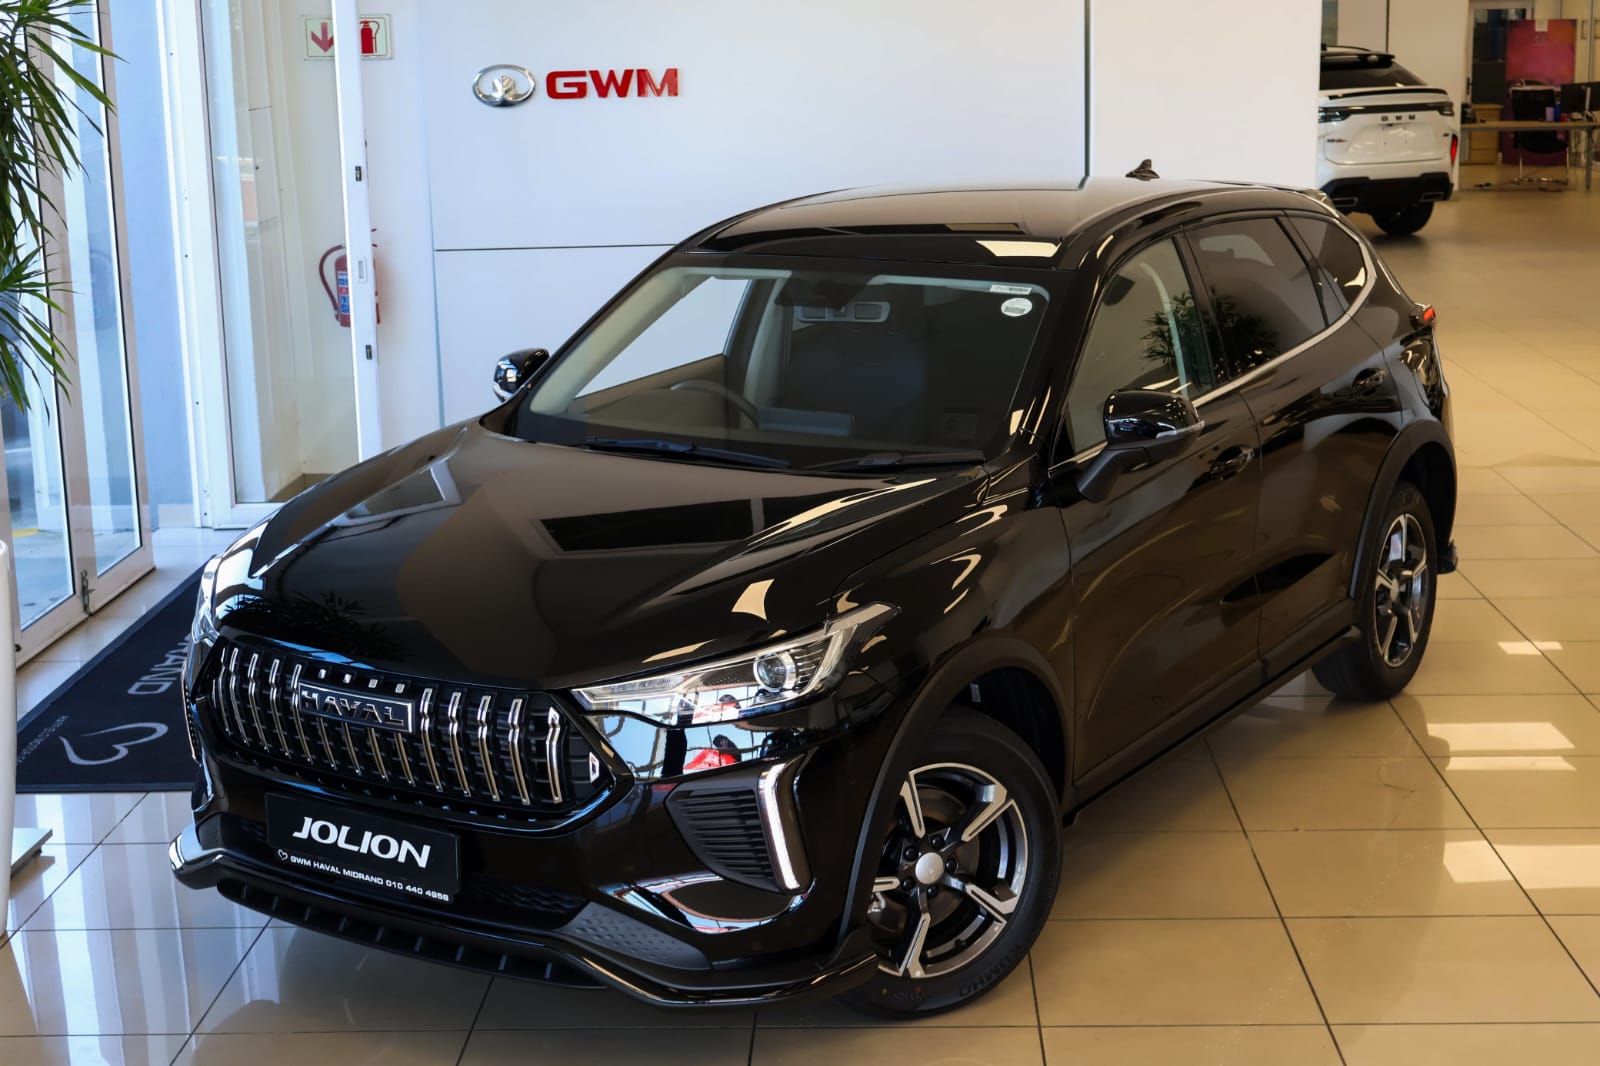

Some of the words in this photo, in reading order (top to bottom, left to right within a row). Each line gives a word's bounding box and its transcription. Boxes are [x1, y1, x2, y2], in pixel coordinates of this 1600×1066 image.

[546, 68, 679, 99] GWM
[127, 632, 192, 695] RAND
[300, 689, 405, 727] HAVAL
[292, 816, 431, 869] JOLION
[290, 855, 312, 867] GWM
[313, 860, 341, 874] HAVAL
[342, 868, 384, 885] MIDRAND
[385, 879, 404, 890] 010
[405, 884, 423, 896] 440
